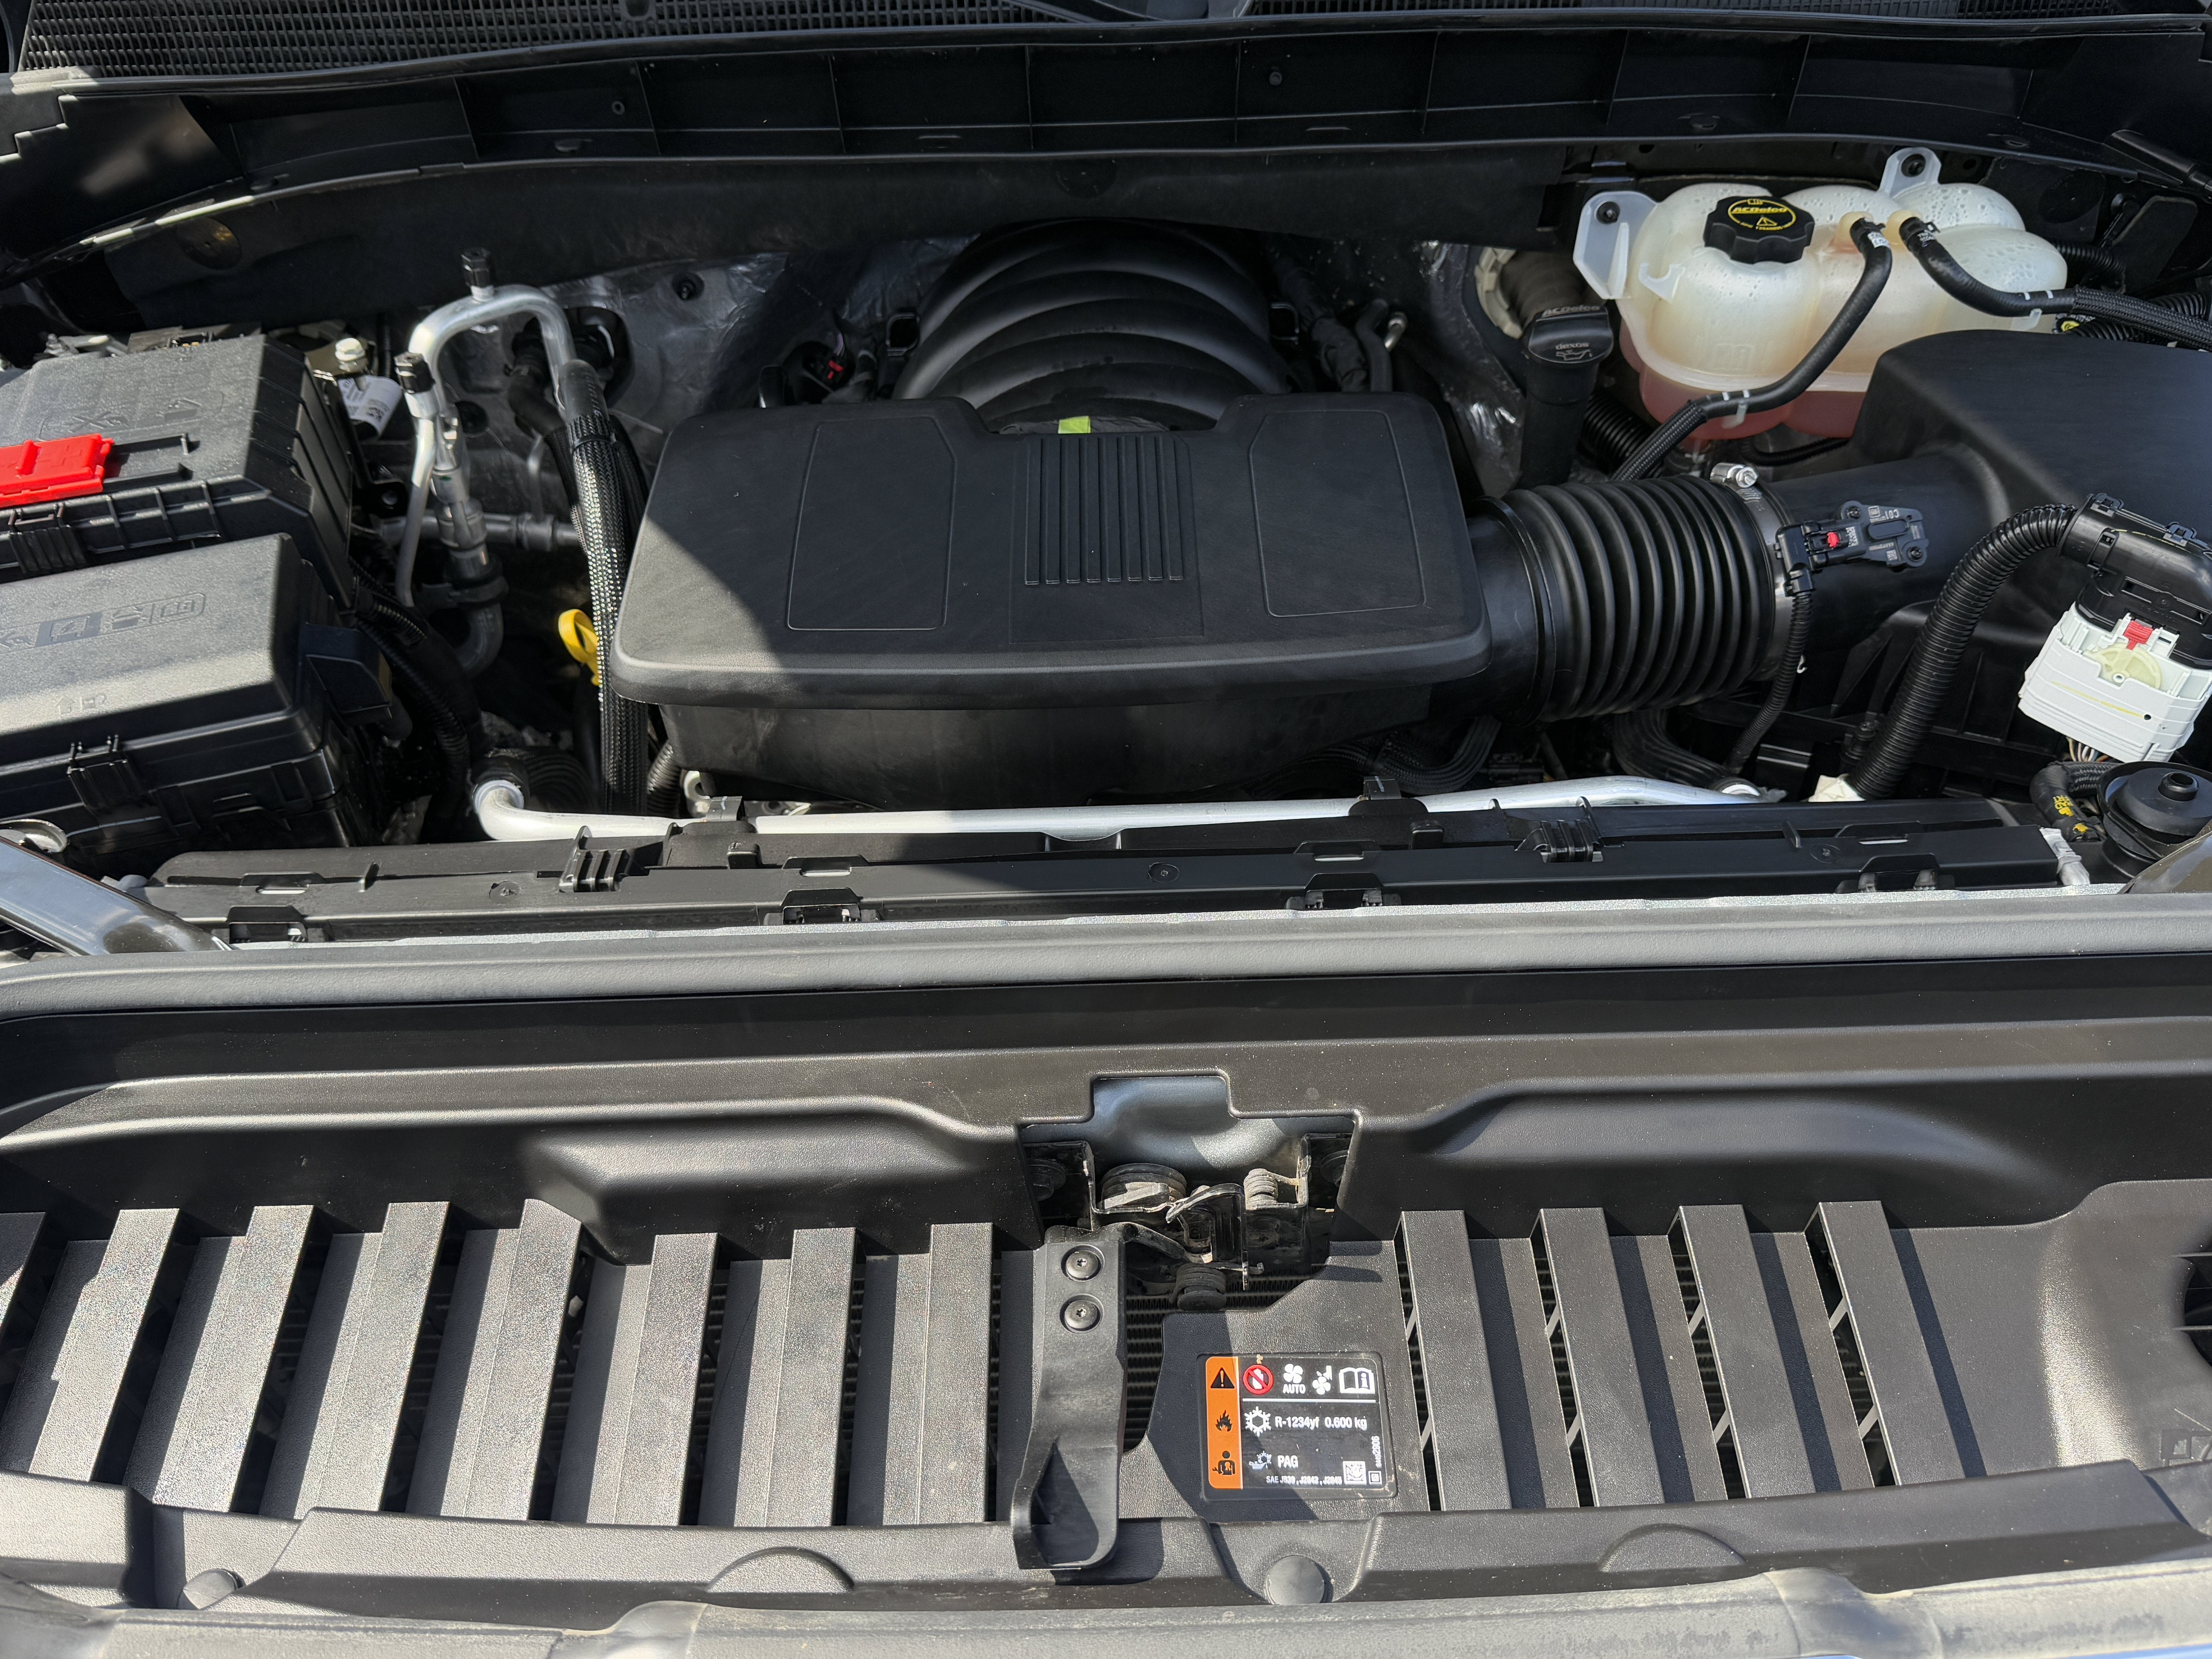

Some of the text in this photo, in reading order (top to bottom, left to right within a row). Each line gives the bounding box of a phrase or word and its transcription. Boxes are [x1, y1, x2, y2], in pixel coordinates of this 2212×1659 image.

[1541, 305, 1600, 318] ACDelco
[1283, 1384, 1306, 1394] AUTO
[1274, 1416, 1367, 1431] R-1234yf 0.600 kg
[1278, 1455, 1298, 1468] PAG
[1266, 1475, 1279, 1484] SAE
